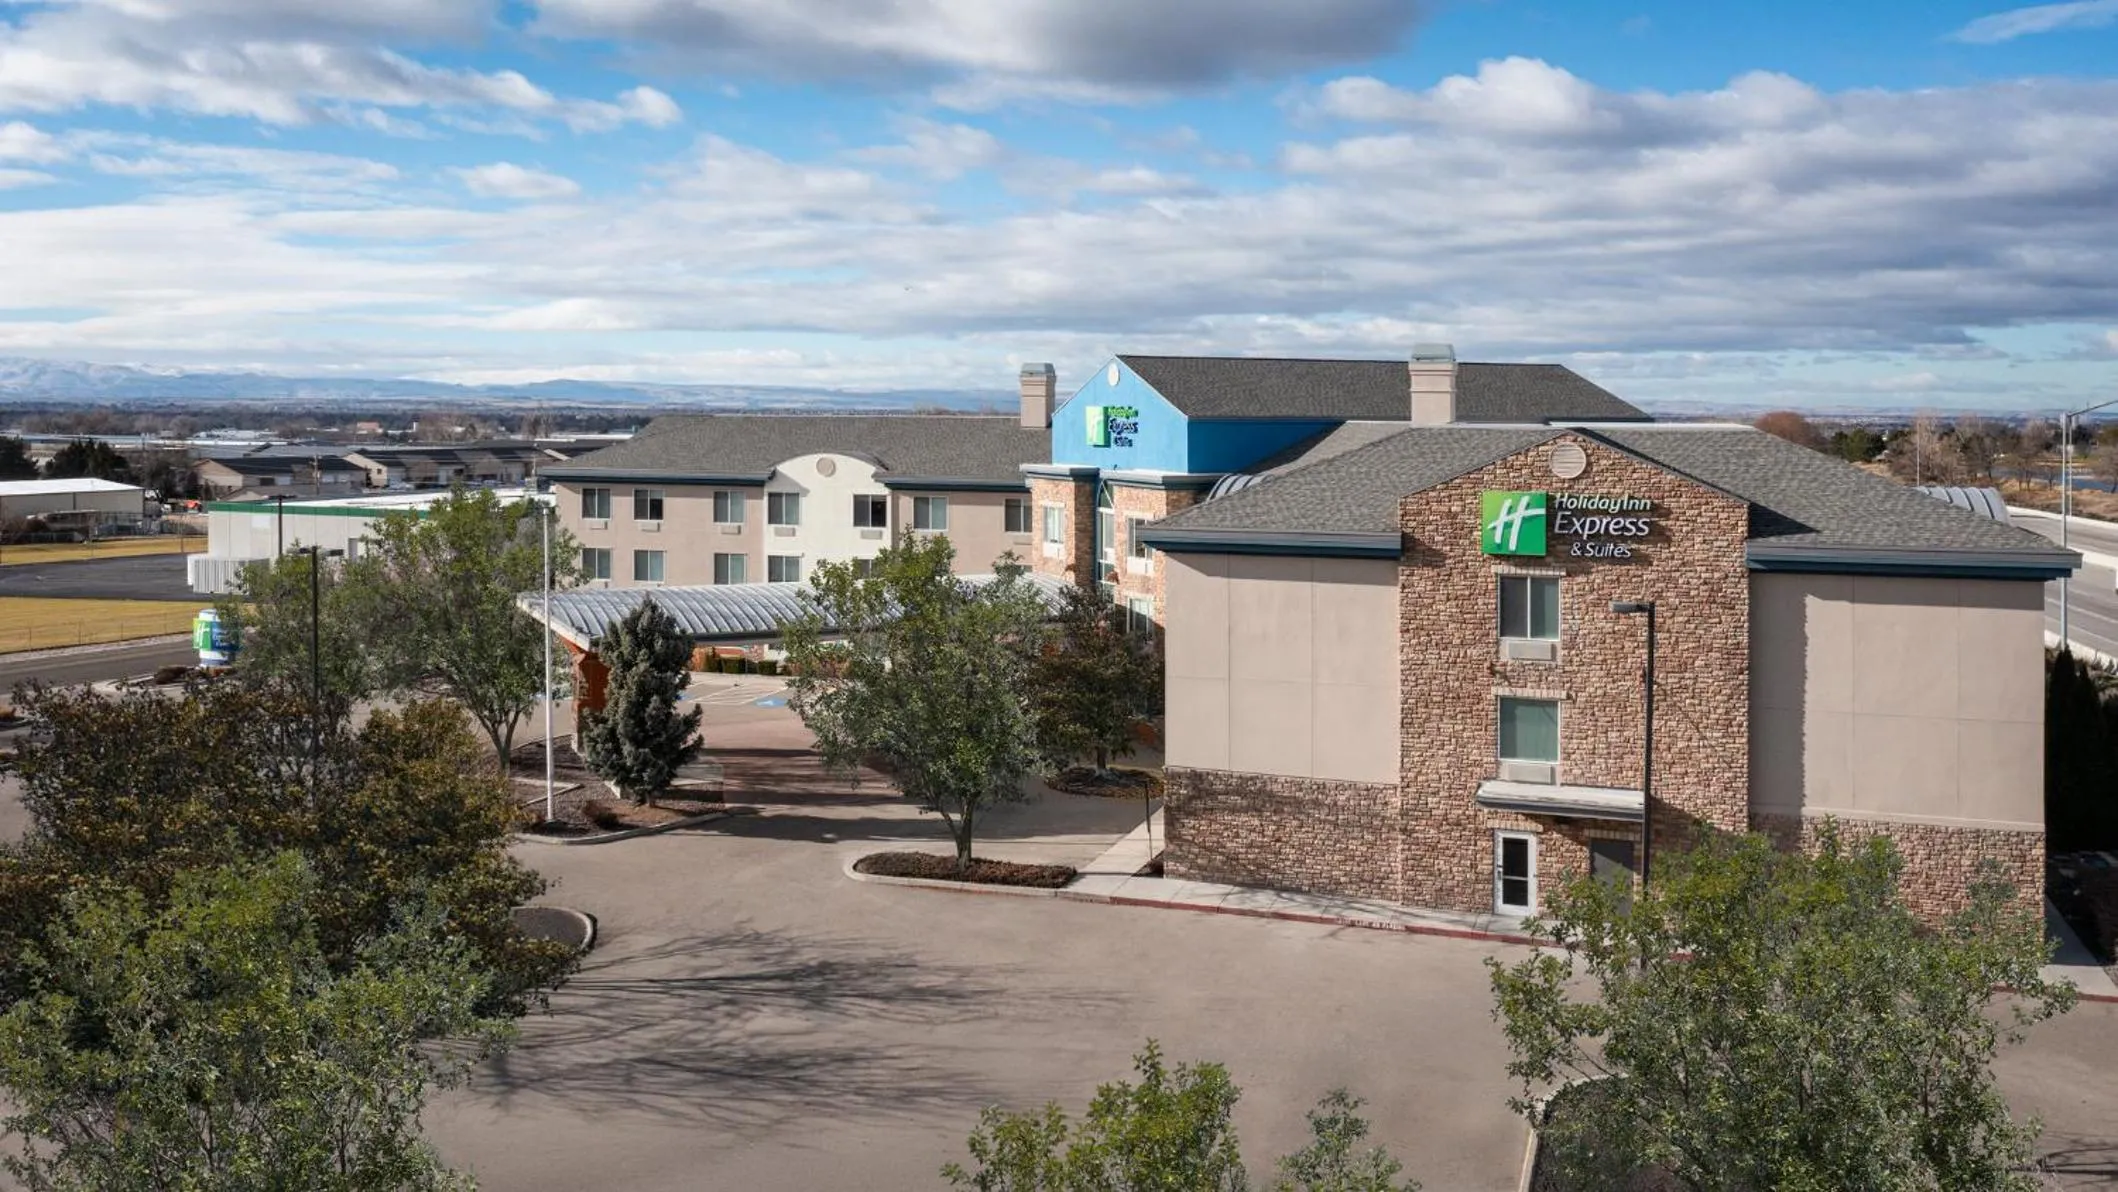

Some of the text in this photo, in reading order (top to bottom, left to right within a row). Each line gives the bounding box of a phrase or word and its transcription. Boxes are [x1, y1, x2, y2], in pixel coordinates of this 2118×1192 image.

[1554, 511, 1650, 540] Express
[1570, 542, 1631, 558] & Suites
